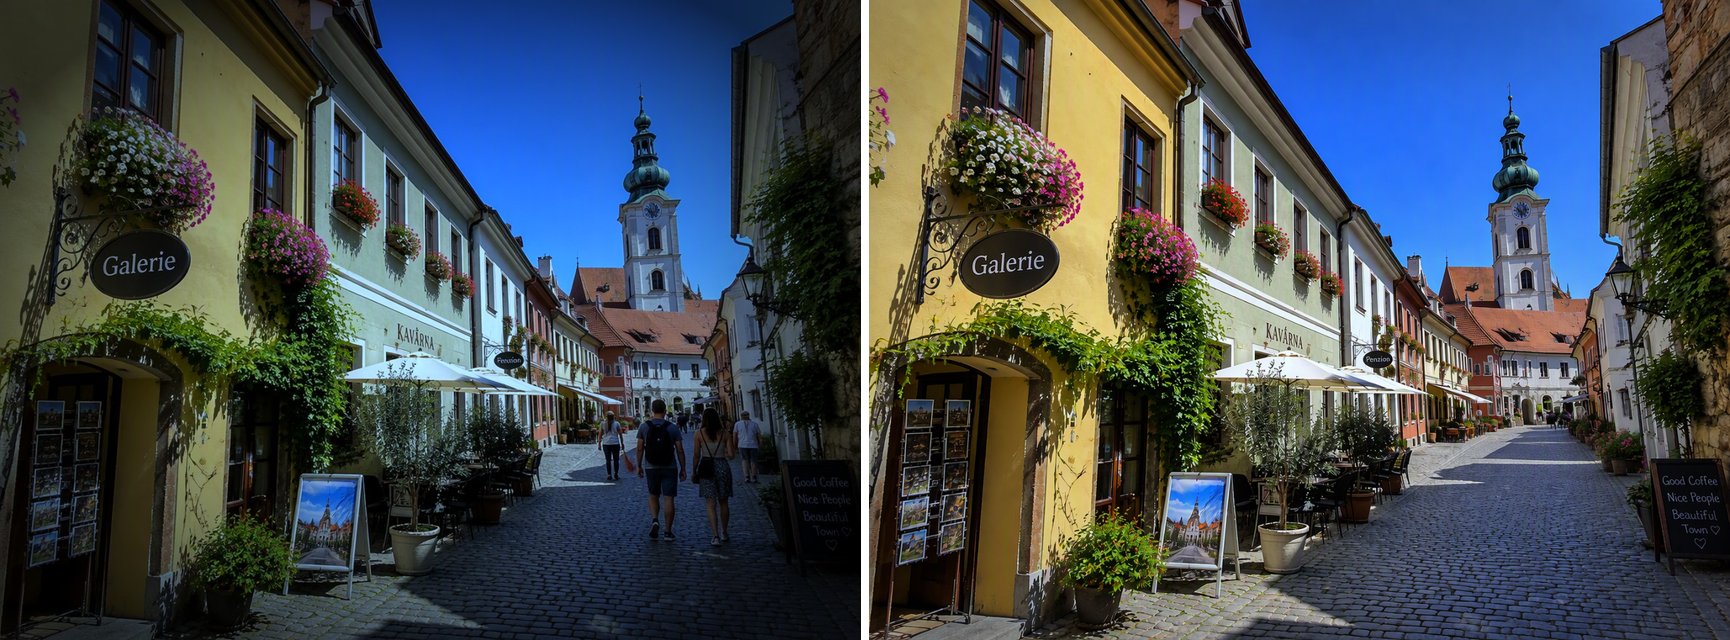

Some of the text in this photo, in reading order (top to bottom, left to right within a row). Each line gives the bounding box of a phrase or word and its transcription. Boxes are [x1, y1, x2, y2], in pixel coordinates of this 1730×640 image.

[103, 250, 177, 277] Galerie
[972, 250, 1045, 276] Galerie
[1266, 322, 1303, 349] KAVÁRNA
[1365, 355, 1391, 363] Penzion
[793, 477, 849, 488] Good Coffee
[1662, 475, 1718, 486] Good Coffee
[797, 493, 852, 508] Nice People
[1667, 492, 1720, 506] Nice People
[802, 510, 849, 523] Beautiful
[1671, 509, 1718, 521] Beautiful
[813, 525, 840, 537] Town
[1681, 523, 1708, 535] Town
